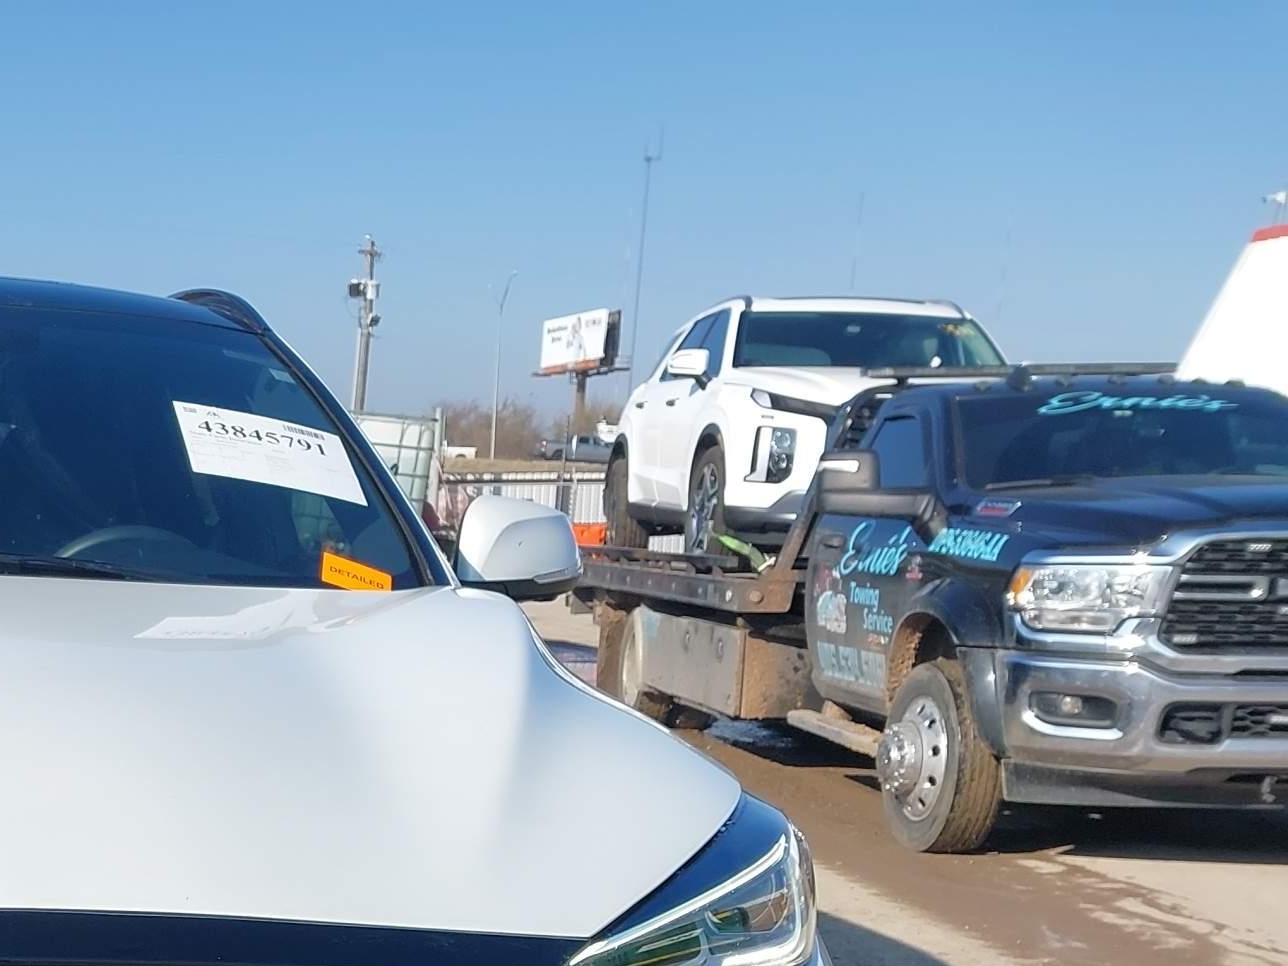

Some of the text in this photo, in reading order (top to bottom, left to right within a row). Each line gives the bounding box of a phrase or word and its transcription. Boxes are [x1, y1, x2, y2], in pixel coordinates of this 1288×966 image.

[197, 420, 327, 457] 43845791
[328, 565, 385, 590] DETAILED
[848, 580, 880, 613] Towing
[862, 605, 894, 635] Service
